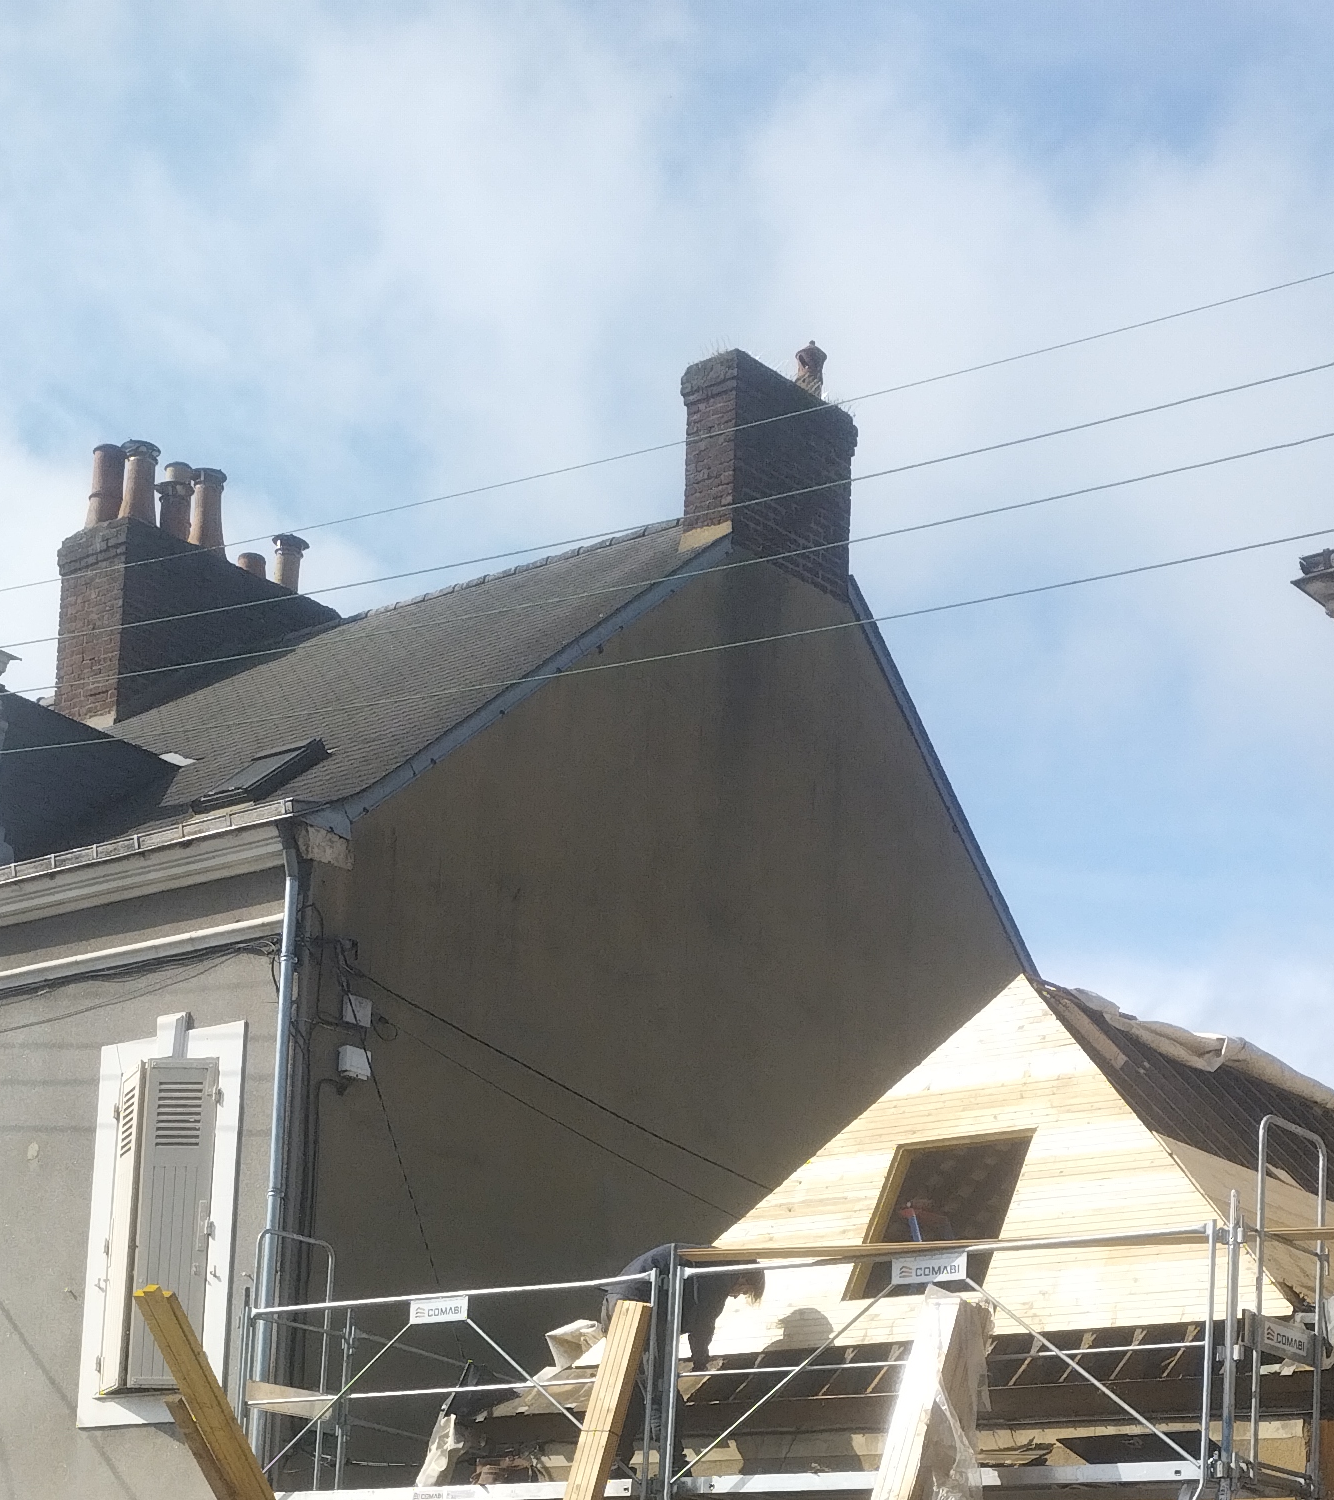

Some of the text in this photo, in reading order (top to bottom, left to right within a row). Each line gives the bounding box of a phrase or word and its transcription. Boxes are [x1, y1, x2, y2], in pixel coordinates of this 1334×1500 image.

[915, 1264, 960, 1277] COMABI
[428, 1306, 462, 1317] COMABI
[1276, 1333, 1305, 1352] COMABI
